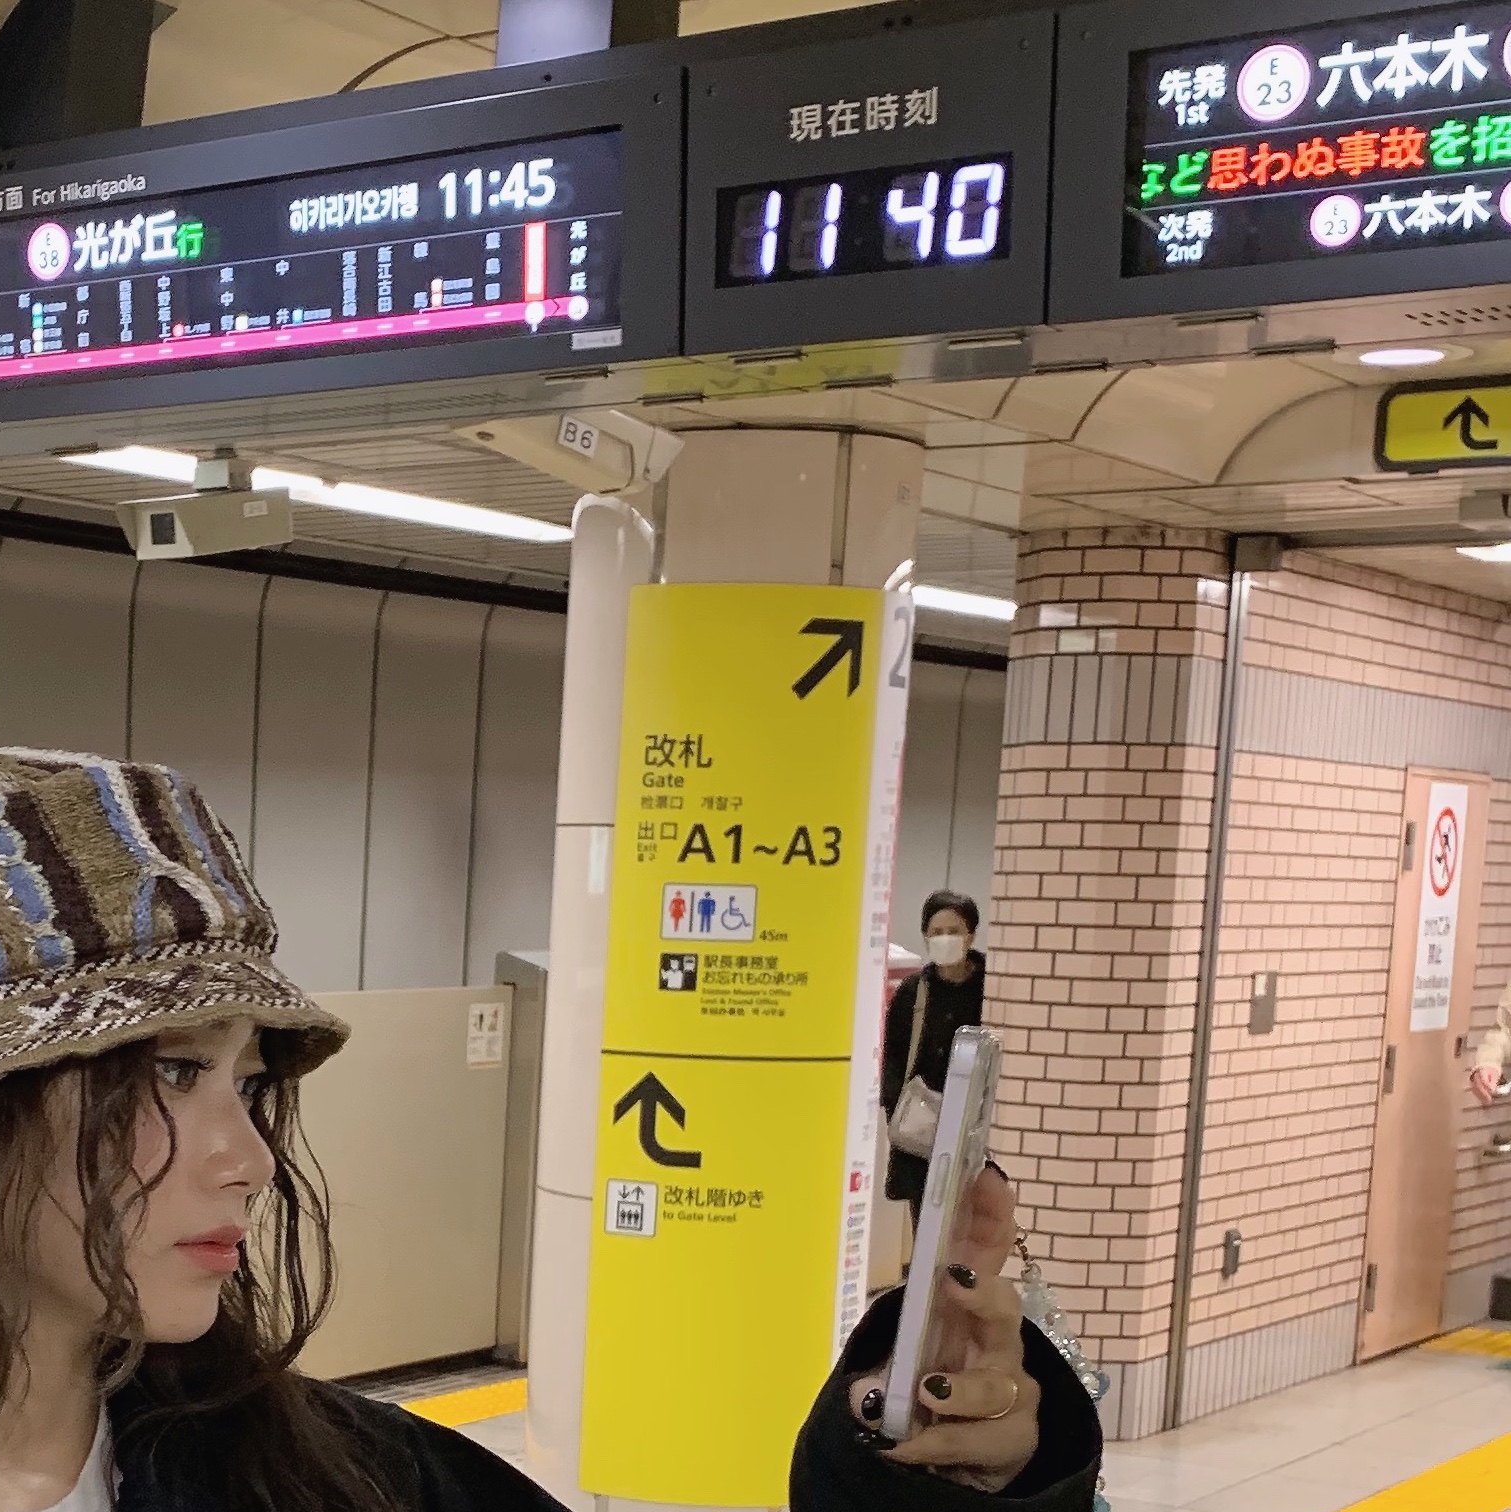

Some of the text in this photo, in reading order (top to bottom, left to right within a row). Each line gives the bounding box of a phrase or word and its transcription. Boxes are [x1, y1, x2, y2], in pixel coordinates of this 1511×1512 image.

[1270, 58, 1279, 75] E
[1316, 25, 1490, 107] 六本木
[1159, 64, 1227, 105] 先発
[1257, 81, 1292, 107] 23
[789, 87, 938, 141] 現在時刻
[1175, 102, 1209, 126] 1st
[32, 174, 146, 207] For Hikarigaoka
[439, 158, 557, 219] 11:45
[1362, 186, 1492, 238] 六本木
[1158, 210, 1214, 241] 次発
[1324, 219, 1349, 236] 23
[39, 251, 59, 269] 38
[570, 220, 587, 291] 光が丘
[1166, 241, 1203, 263] 2nd
[889, 607, 913, 688] 2
[644, 734, 712, 768] 改札
[642, 772, 684, 788] Gate
[637, 821, 678, 840] 出口
[759, 929, 788, 942] 45m
[704, 955, 778, 969] 駅長事務室
[663, 1185, 764, 1209] 改札階ゆき
